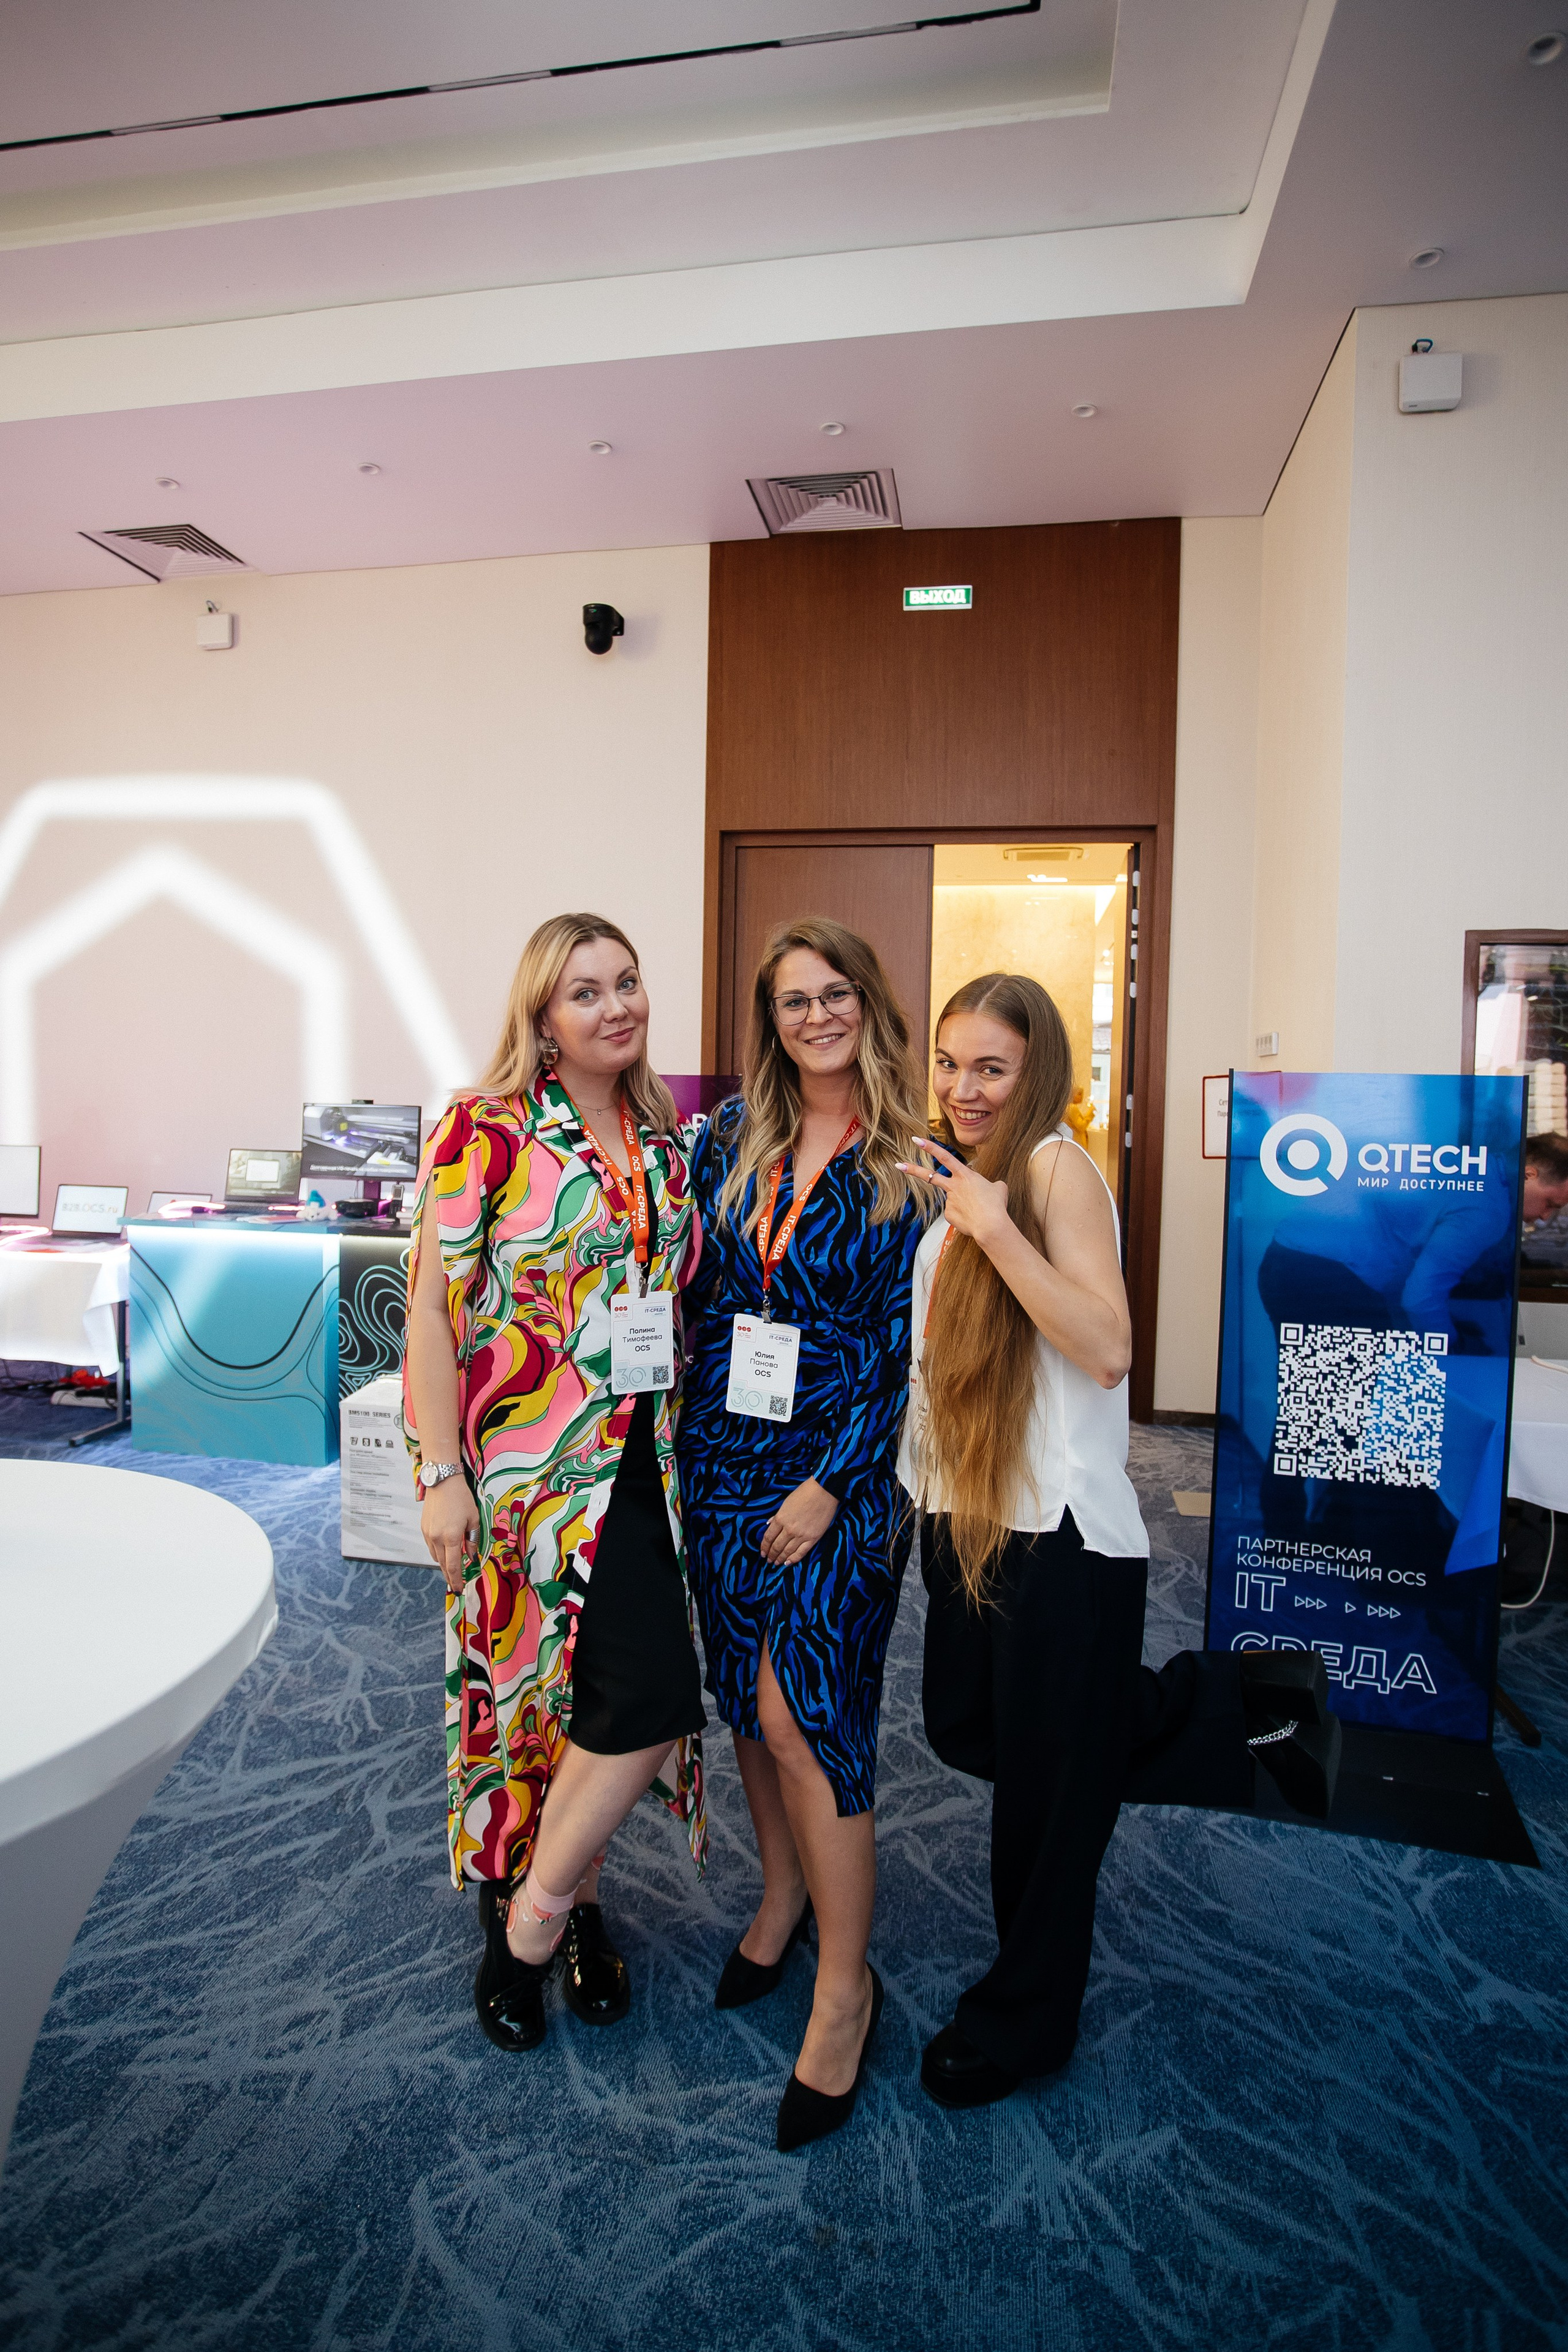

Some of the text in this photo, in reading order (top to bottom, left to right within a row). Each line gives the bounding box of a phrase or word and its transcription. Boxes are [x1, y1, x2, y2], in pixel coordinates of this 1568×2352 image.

[909, 589, 966, 604] ВЫХОД
[584, 1129, 612, 1166] IT-СРЕДА
[631, 1155, 641, 1172] OCS
[1357, 1143, 1487, 1175] QTECH
[617, 1176, 629, 1195] OCS
[799, 1183, 813, 1202] OCS
[1357, 1177, 1485, 1192] МИР ДОСТУПНЕЕ
[635, 1185, 646, 1229] IT-СРЕДА
[772, 1215, 796, 1261] IT-СРЕДА
[622, 1334, 663, 1343] Тимофеева
[750, 1358, 778, 1368] Панова
[755, 1351, 775, 1360] Юлия
[616, 1366, 647, 1389] 30
[755, 1369, 771, 1378] OCS
[731, 1387, 763, 1411] 30
[1238, 1536, 1371, 1563] ПАРТНЕРСКАЯ
[1237, 1553, 1427, 1586] КОНФЕРЕНЦИЯ OCS
[1235, 1572, 1286, 1611] IT
